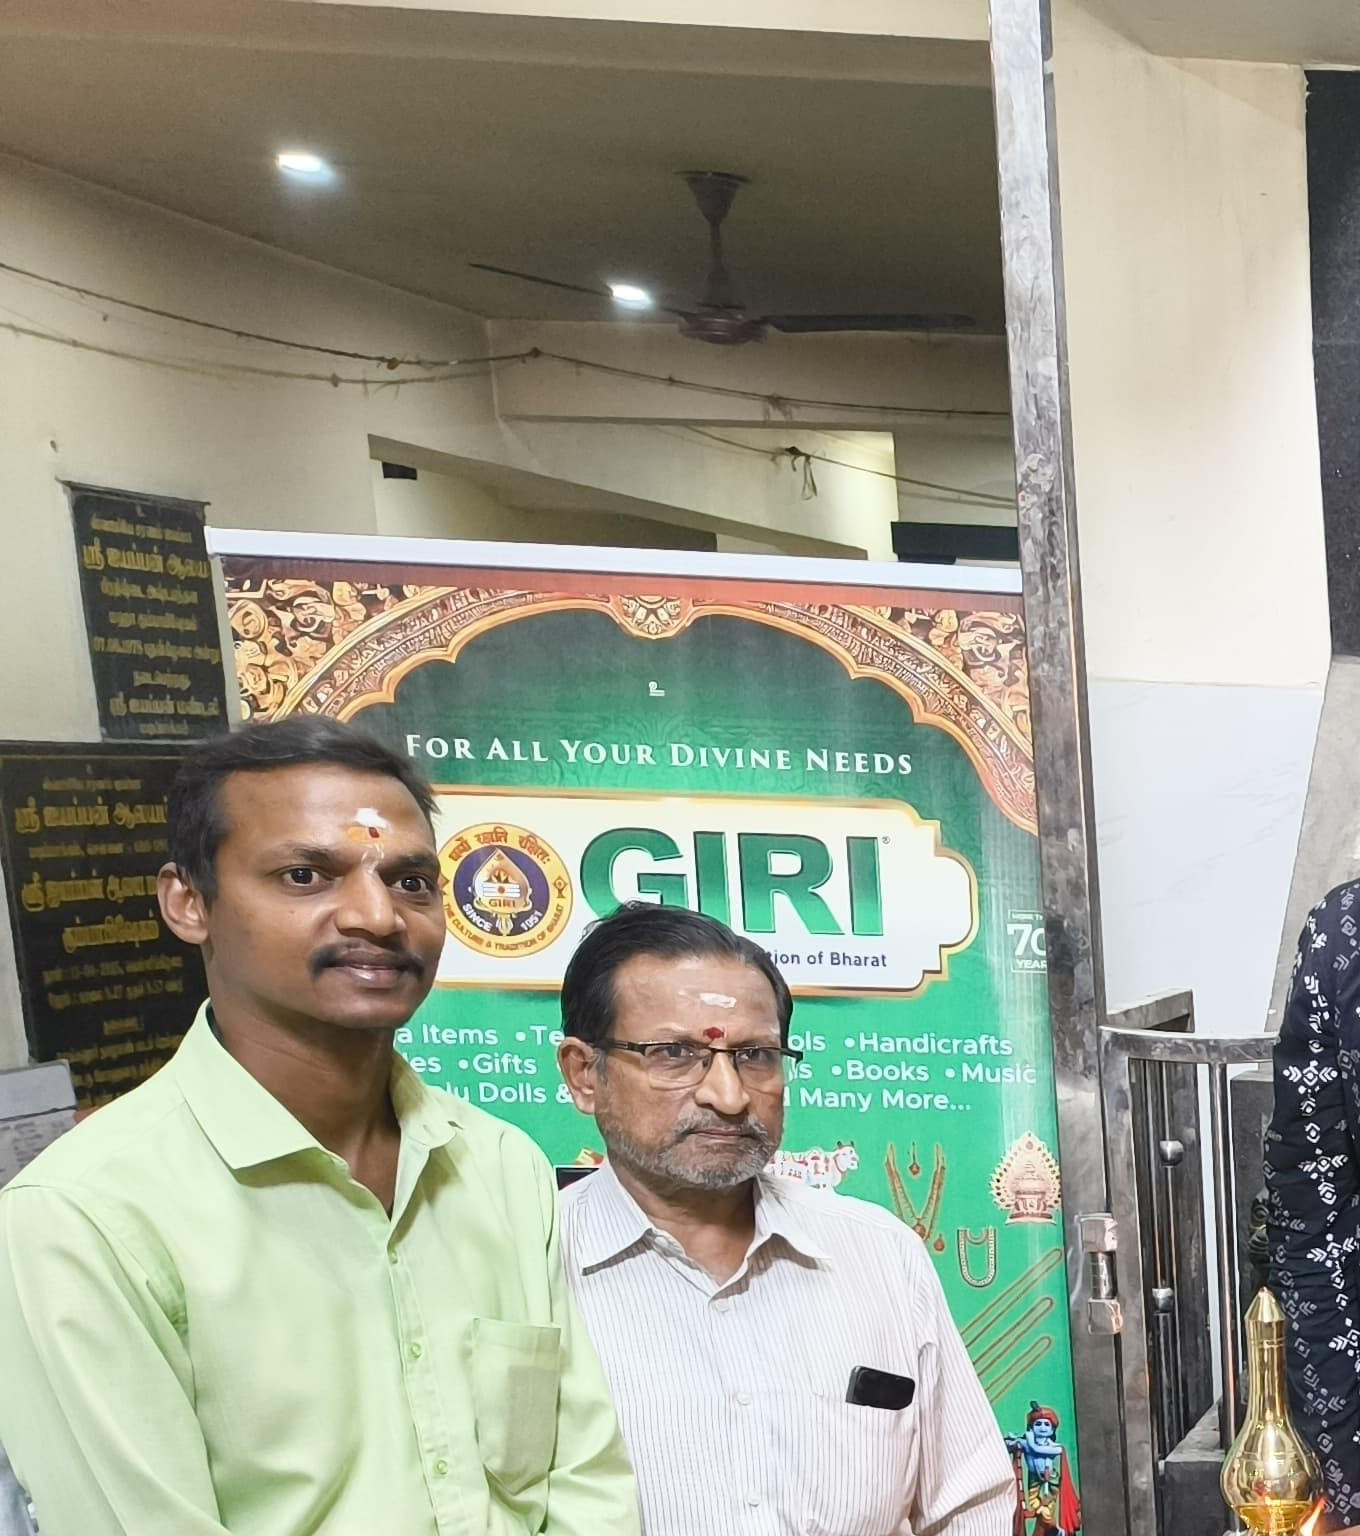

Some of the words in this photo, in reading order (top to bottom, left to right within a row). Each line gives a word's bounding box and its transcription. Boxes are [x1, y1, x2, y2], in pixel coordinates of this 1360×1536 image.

[406, 734, 476, 760] FOR
[486, 737, 549, 763] ALL
[560, 739, 657, 766] YOUR
[670, 743, 792, 771] DIVINE
[806, 748, 912, 775] NEEDS
[580, 826, 884, 937] GIRI
[462, 903, 493, 932] SINCE
[806, 951, 824, 965] of
[830, 951, 888, 967] Bharat
[422, 1023, 498, 1045] Items
[787, 1030, 826, 1051] ols
[859, 1032, 1013, 1056] Handicrafts
[473, 1053, 537, 1075] Gifts
[846, 1060, 929, 1081] Books
[962, 1063, 1037, 1084] Music
[479, 1082, 547, 1103] Dolls
[800, 1087, 872, 1113] Many
